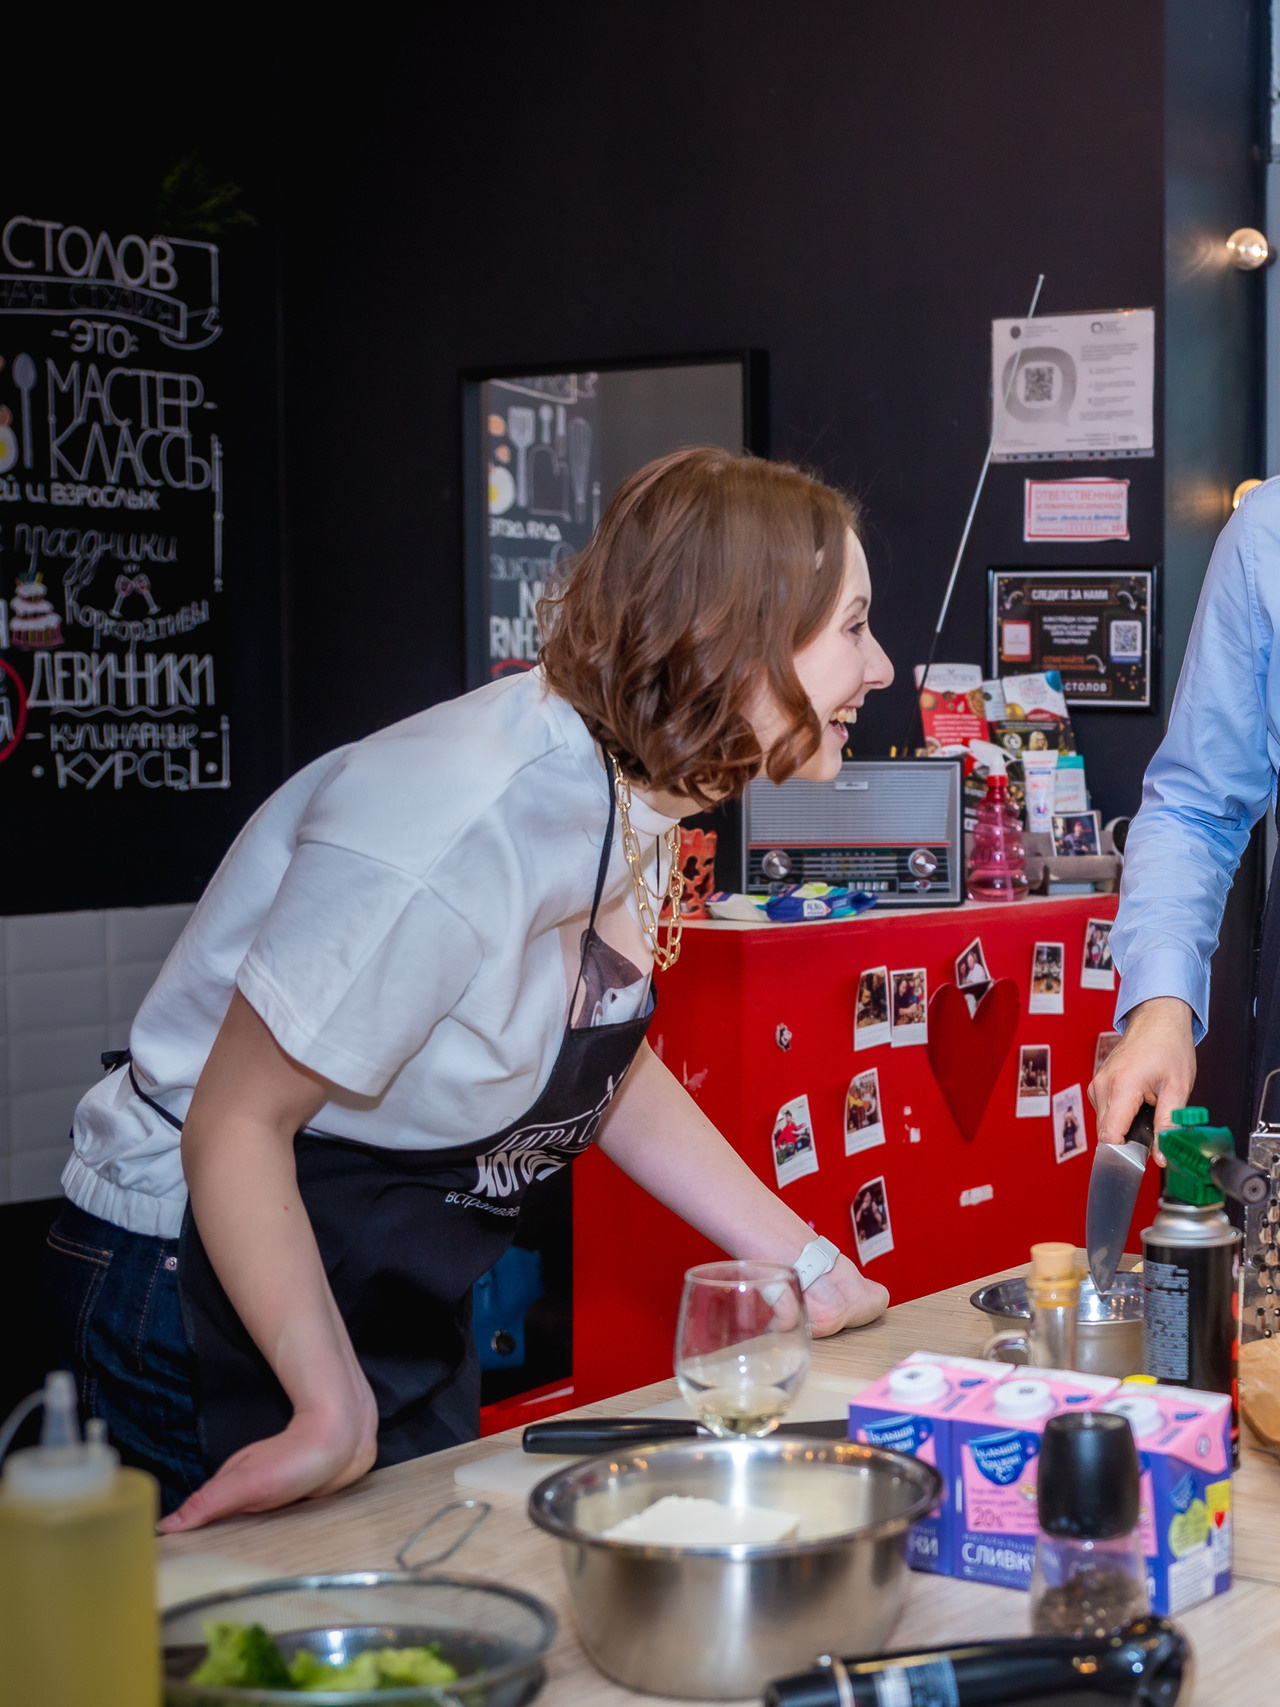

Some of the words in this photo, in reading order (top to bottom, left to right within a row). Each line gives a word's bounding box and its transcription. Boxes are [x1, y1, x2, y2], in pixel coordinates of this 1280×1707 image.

[2, 215, 179, 291] СТОЛОВ
[49, 416, 220, 492] КЛАССЫ
[1070, 589, 1082, 600] ЗА
[1064, 682, 1107, 692] СТОЛОВ
[55, 750, 200, 790] КУРСЫ
